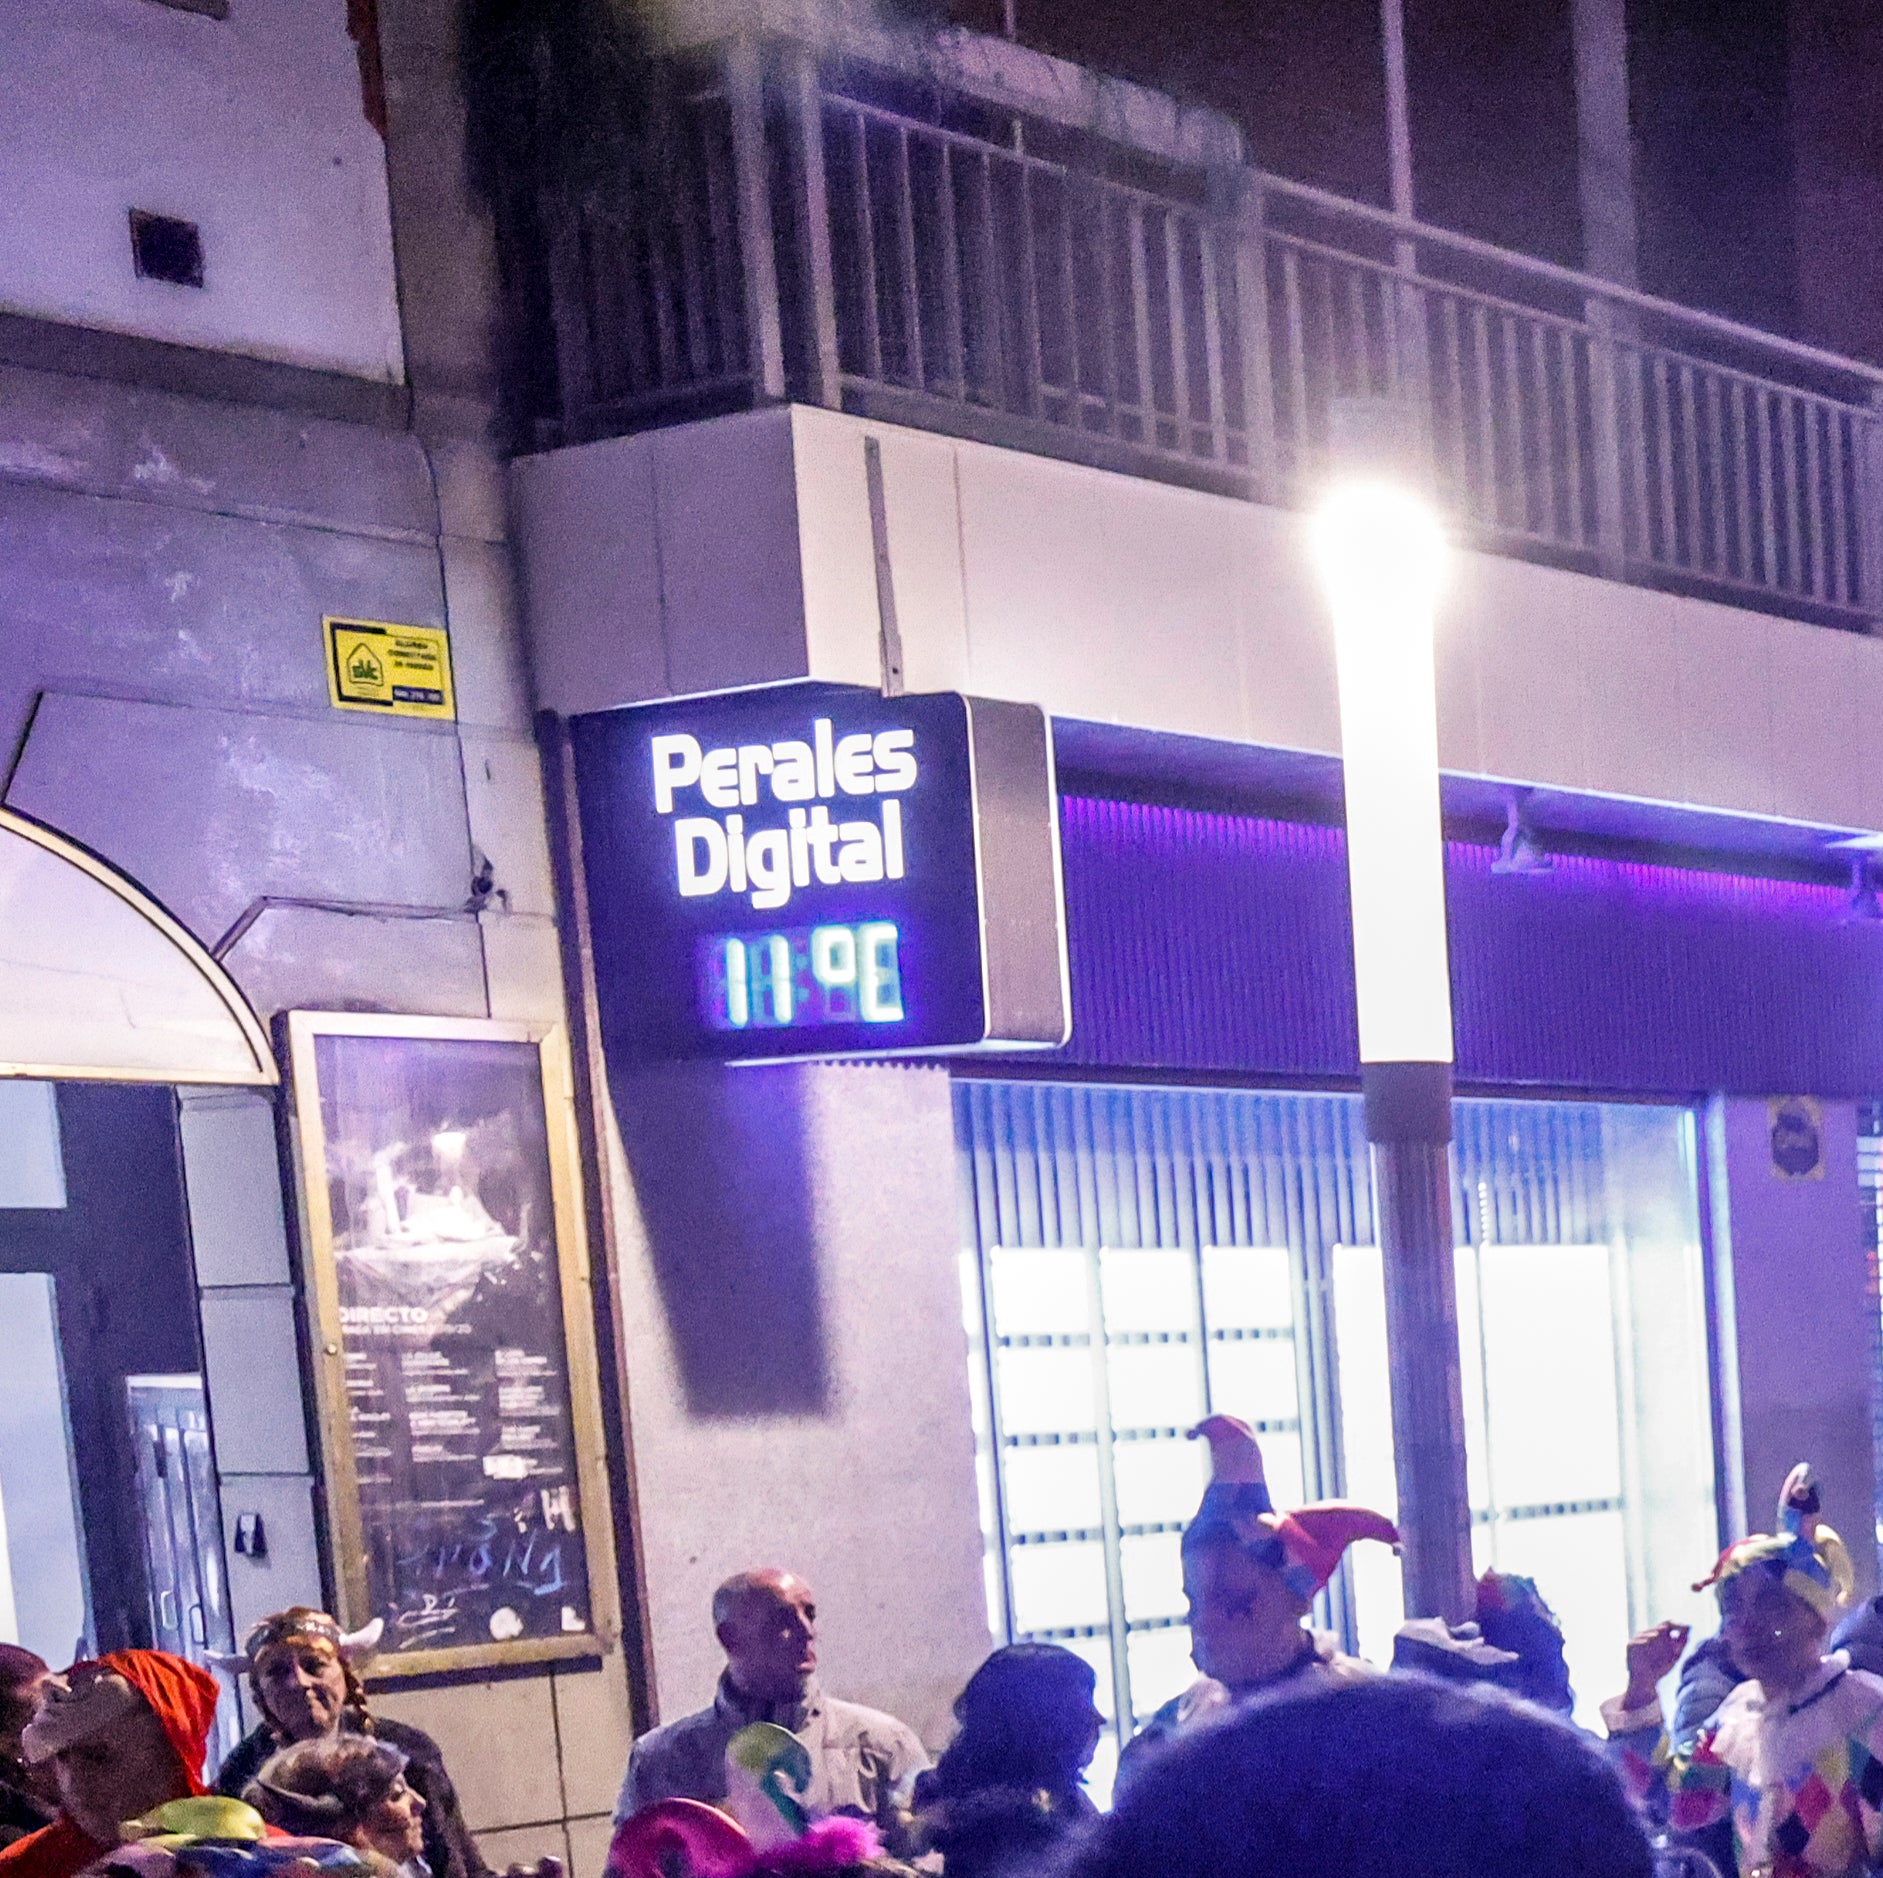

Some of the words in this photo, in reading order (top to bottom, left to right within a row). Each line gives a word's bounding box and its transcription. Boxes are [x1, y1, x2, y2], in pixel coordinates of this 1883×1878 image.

[651, 718, 918, 814] Perales
[674, 799, 905, 910] Digital
[339, 1306, 429, 1323] DIRECTO
